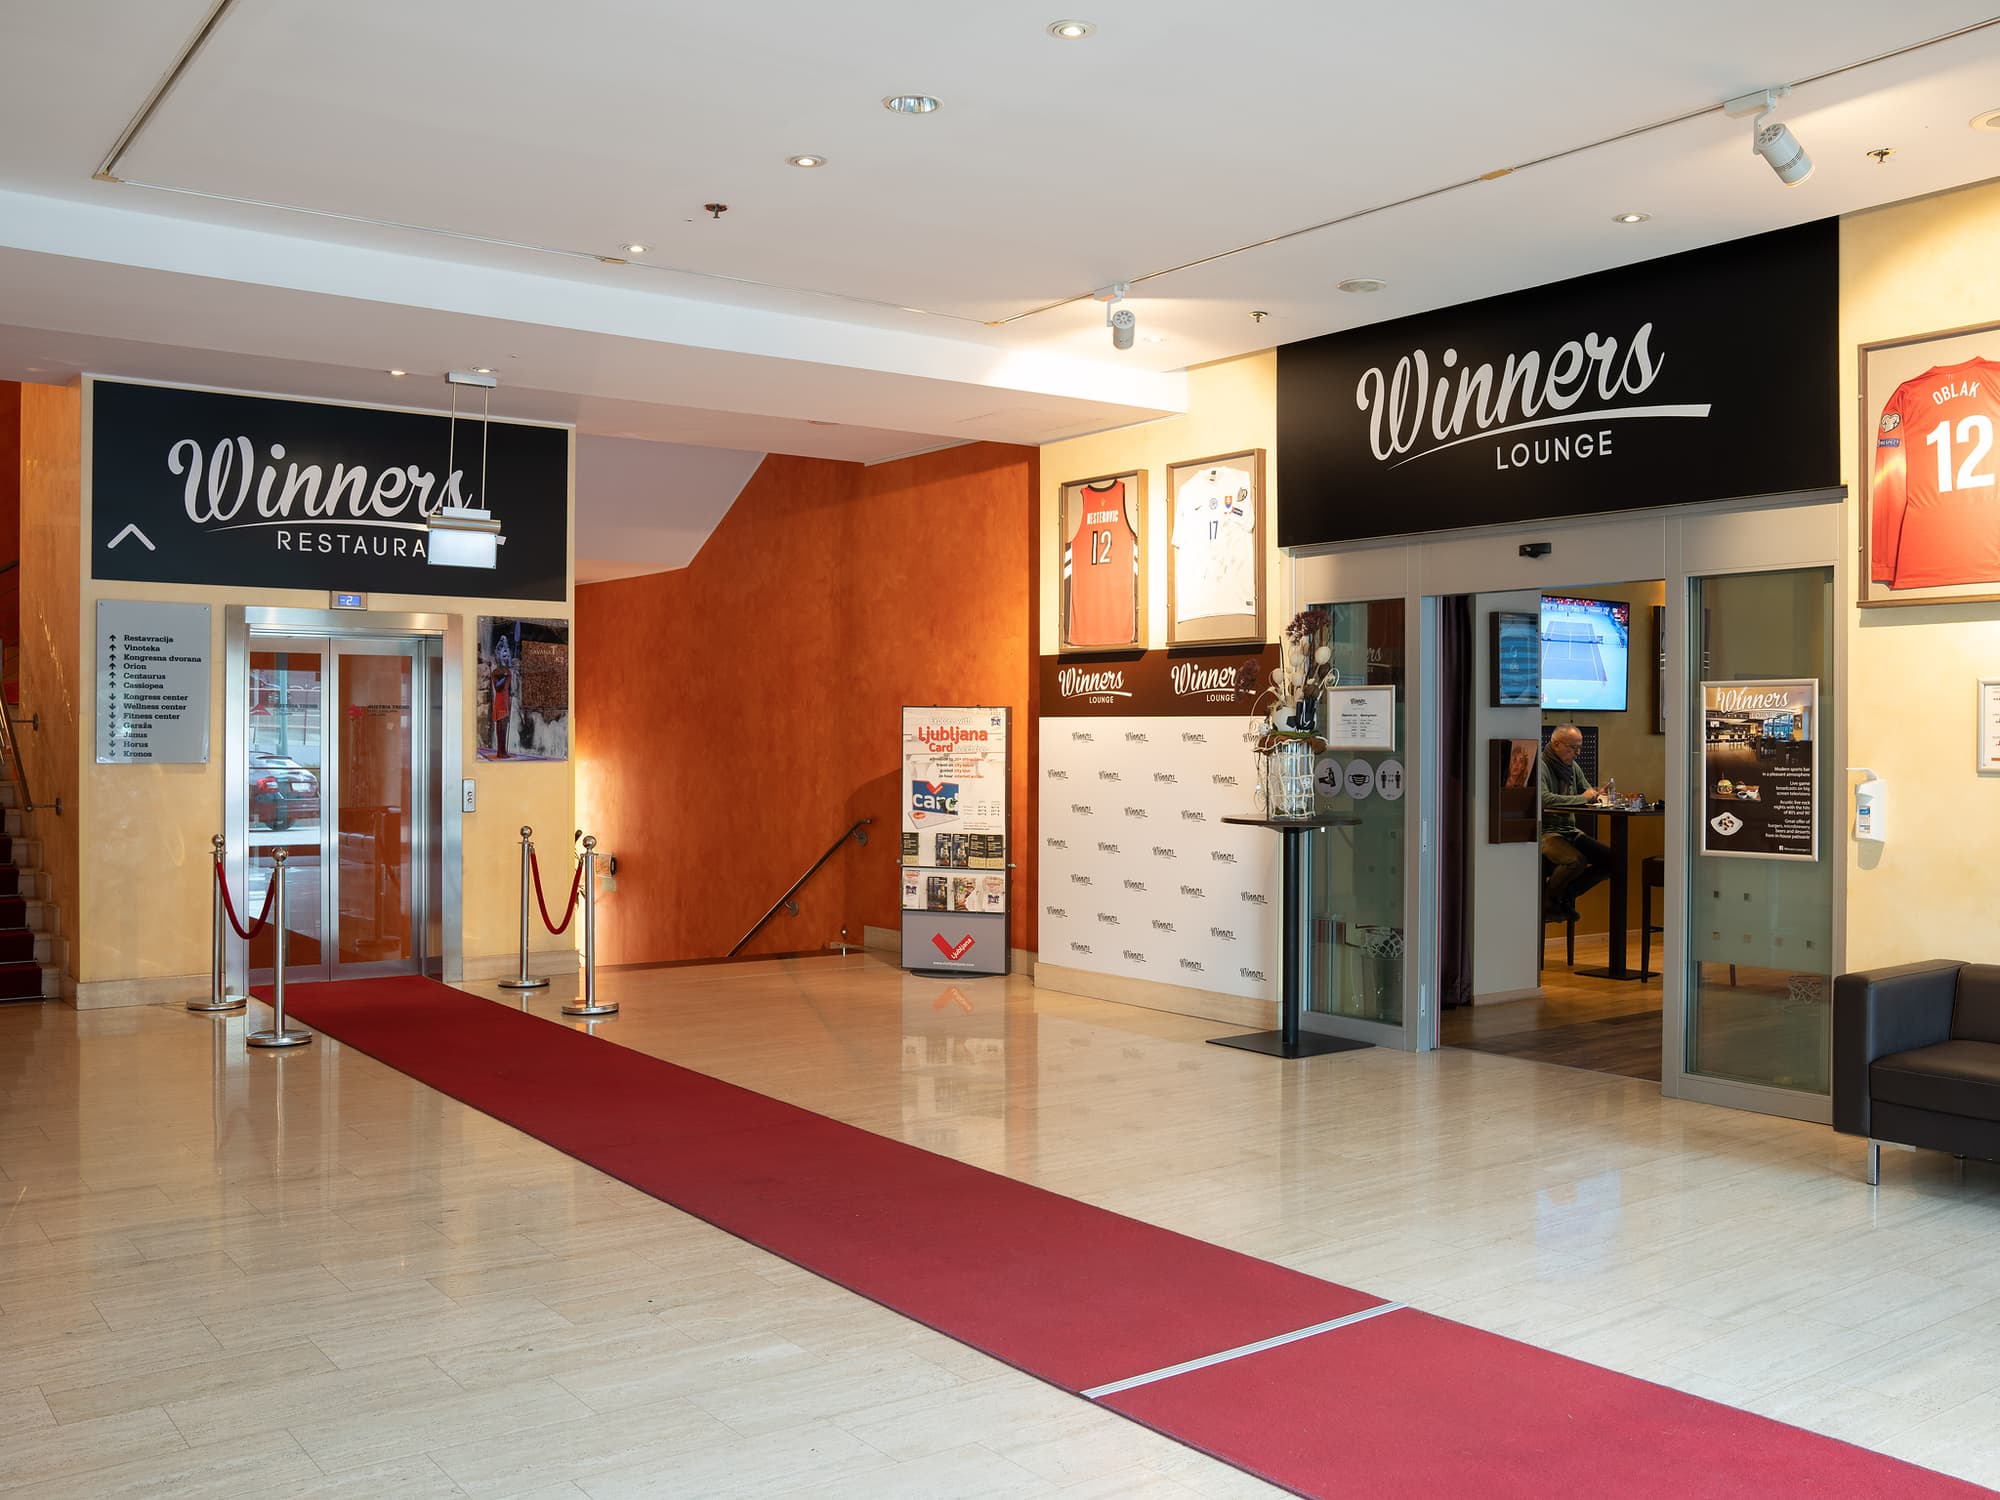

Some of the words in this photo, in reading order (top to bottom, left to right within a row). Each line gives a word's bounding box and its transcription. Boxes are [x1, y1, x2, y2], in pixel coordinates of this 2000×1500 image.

[1356, 321, 1665, 461] Winners
[1932, 381, 1980, 405] OBLAK
[1496, 430, 1613, 470] LOUNGE
[1926, 414, 1995, 493] 12
[167, 436, 473, 524] Winners
[1209, 520, 1219, 540] 17
[277, 530, 427, 558] RESTAURA
[1091, 529, 1112, 565] 12
[124, 634, 174, 644] Restavracija
[124, 644, 160, 652] Vinoteka
[123, 654, 167, 662] Kongresna
[169, 655, 202, 663] dvorana
[123, 672, 166, 680] Centaurus
[1058, 667, 1125, 697] Winners
[1171, 662, 1237, 695] Winner
[123, 682, 164, 690] Cassiopea
[123, 693, 161, 701] Kongress
[1089, 696, 1114, 704] LOUNGE
[1206, 693, 1235, 702] LOUNGE
[1716, 687, 1789, 713] Winners
[918, 726, 988, 744] Ljubljana
[928, 742, 953, 752] Card
[912, 792, 959, 811] card
